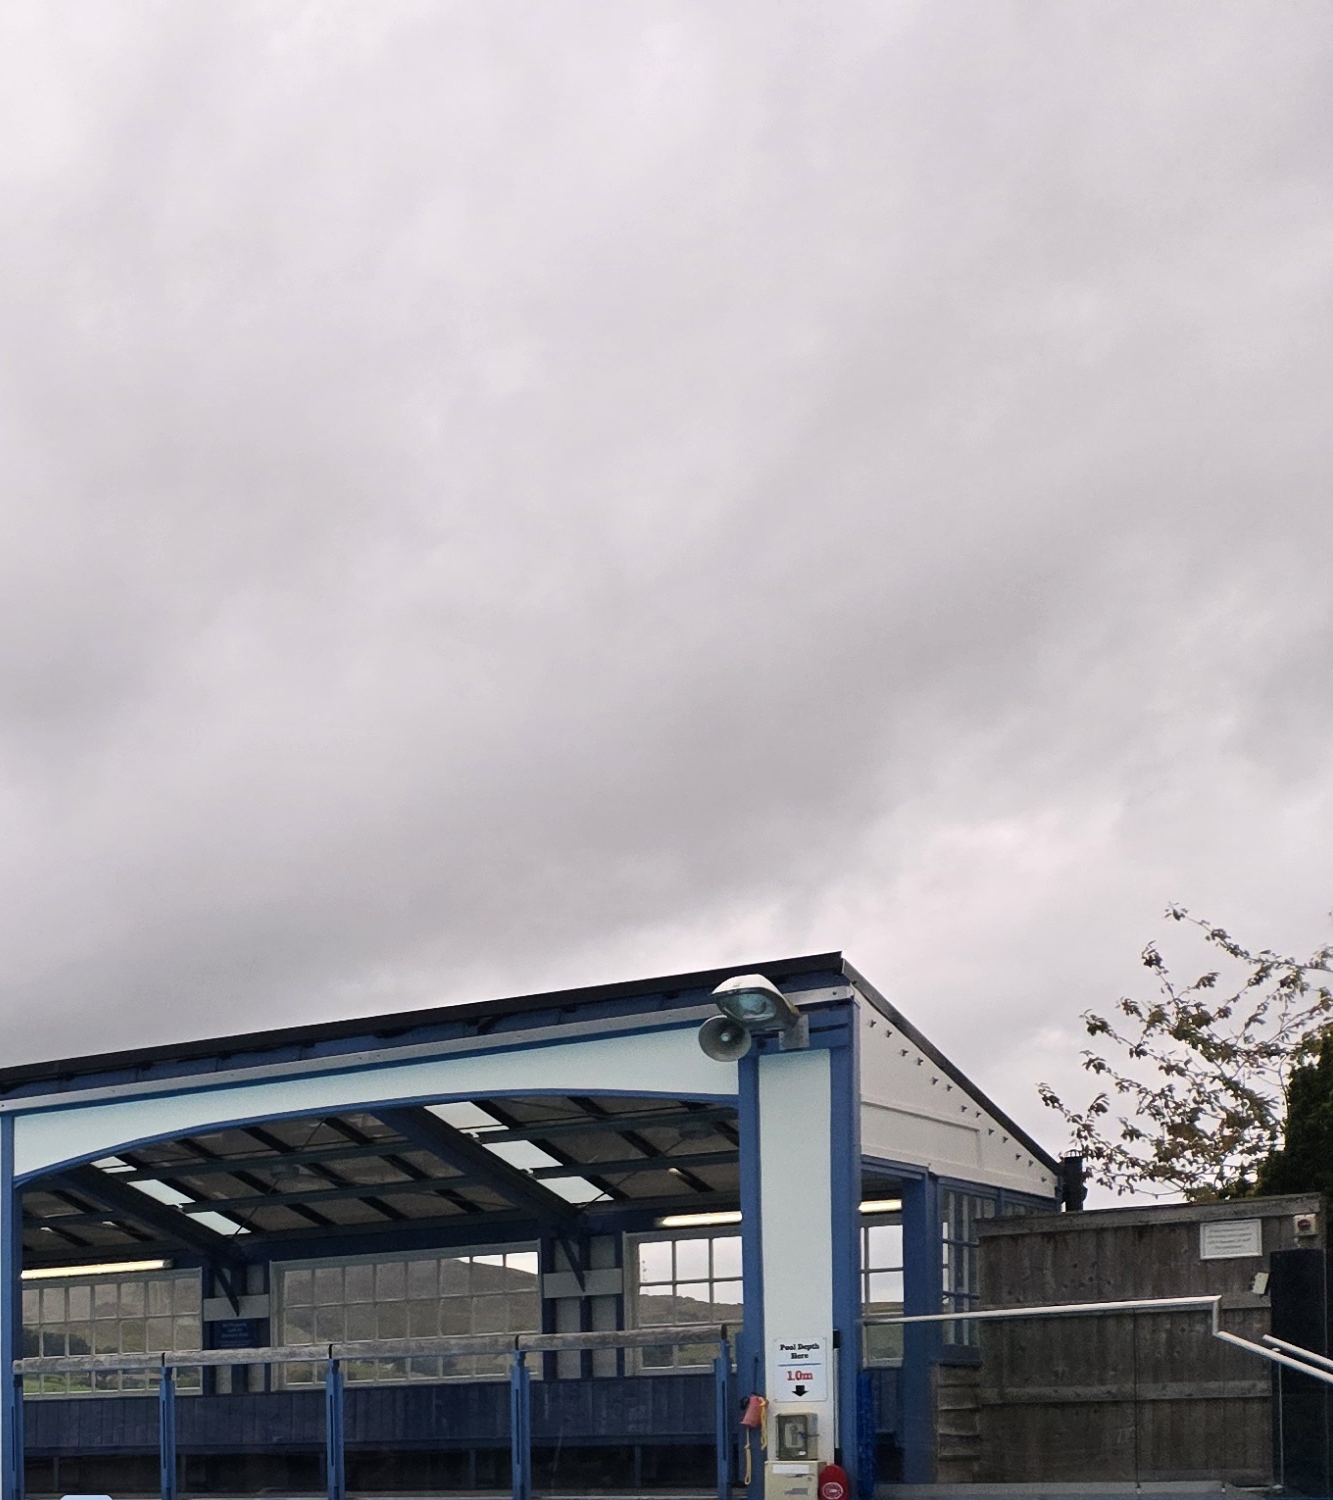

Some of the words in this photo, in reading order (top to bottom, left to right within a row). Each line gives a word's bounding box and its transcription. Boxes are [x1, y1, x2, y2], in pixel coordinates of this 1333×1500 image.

[779, 1343, 796, 1351] Pool
[797, 1343, 820, 1351] Depth
[787, 1370, 813, 1381] 1.0m
